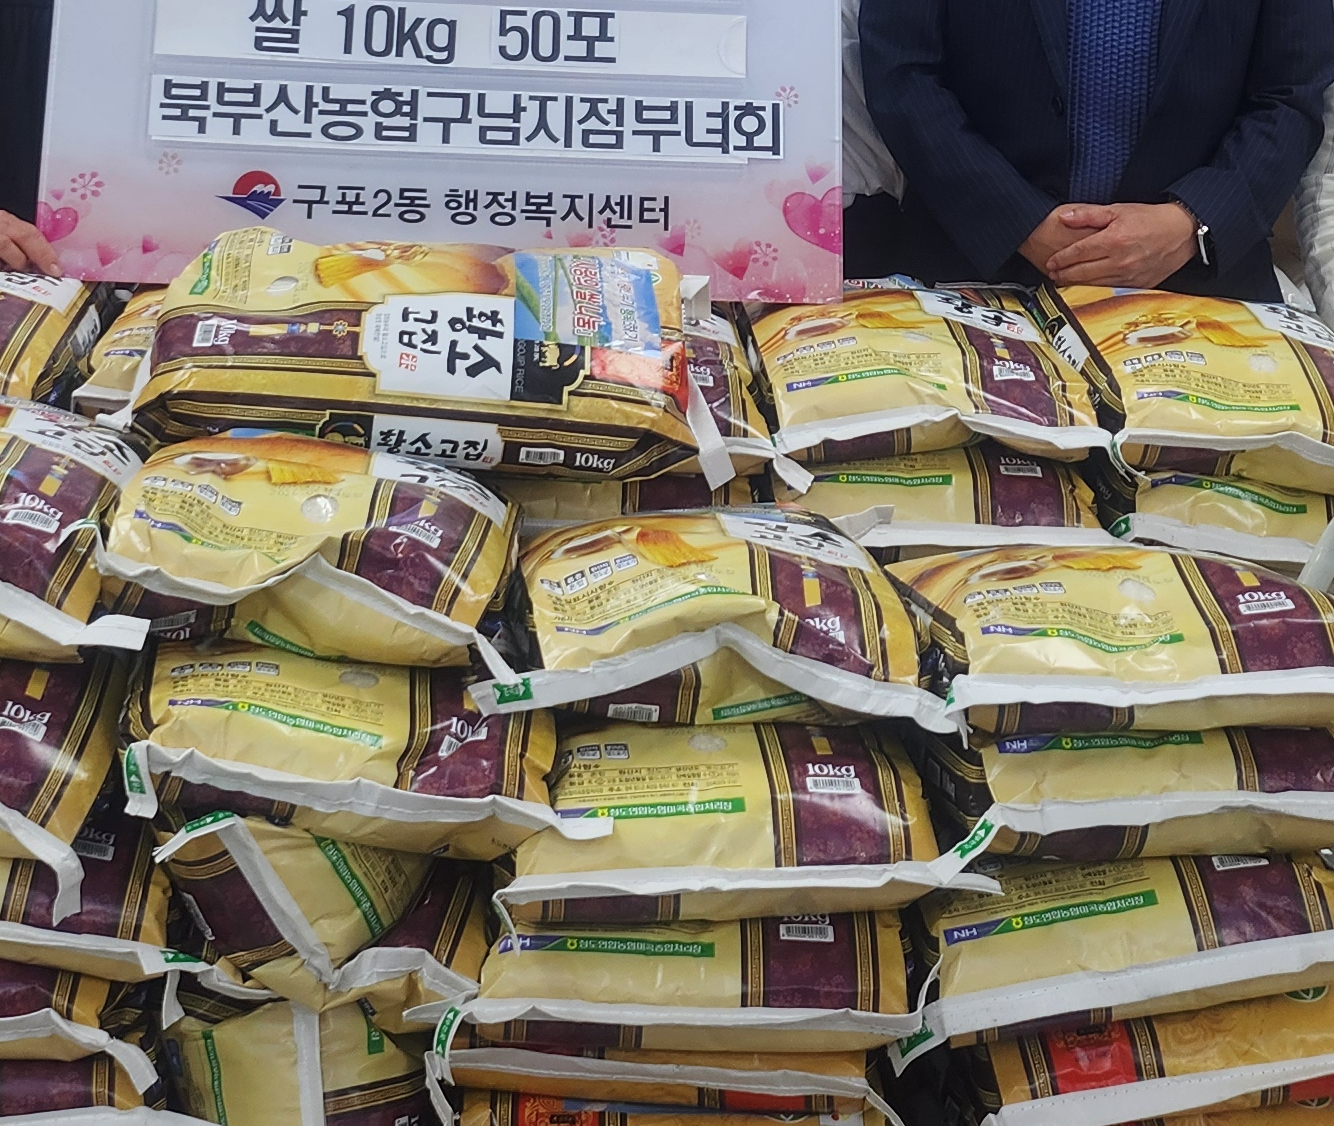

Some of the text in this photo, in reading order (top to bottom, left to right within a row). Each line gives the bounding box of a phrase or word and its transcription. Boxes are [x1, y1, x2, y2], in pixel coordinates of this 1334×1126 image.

[336, 4, 458, 65] 10kg
[496, 9, 617, 65] 50포
[158, 78, 783, 158] 북부산농협구남지점부녀회
[292, 183, 672, 232] 구포2동 행정복지센터
[378, 429, 489, 463] 황소고집
[574, 451, 616, 472] 10kg
[17, 492, 64, 520] 10kg
[1236, 590, 1287, 604] 10kg
[2, 700, 52, 724] 10kg
[1004, 740, 1028, 751] NH
[806, 763, 856, 779] 10kg
[609, 800, 733, 816] 청도연합농협미곡종합처리장
[953, 894, 1145, 939] NH 청도연합농협미곡종합처리장
[578, 938, 703, 955] 청도연합농협미곡종합처리장
